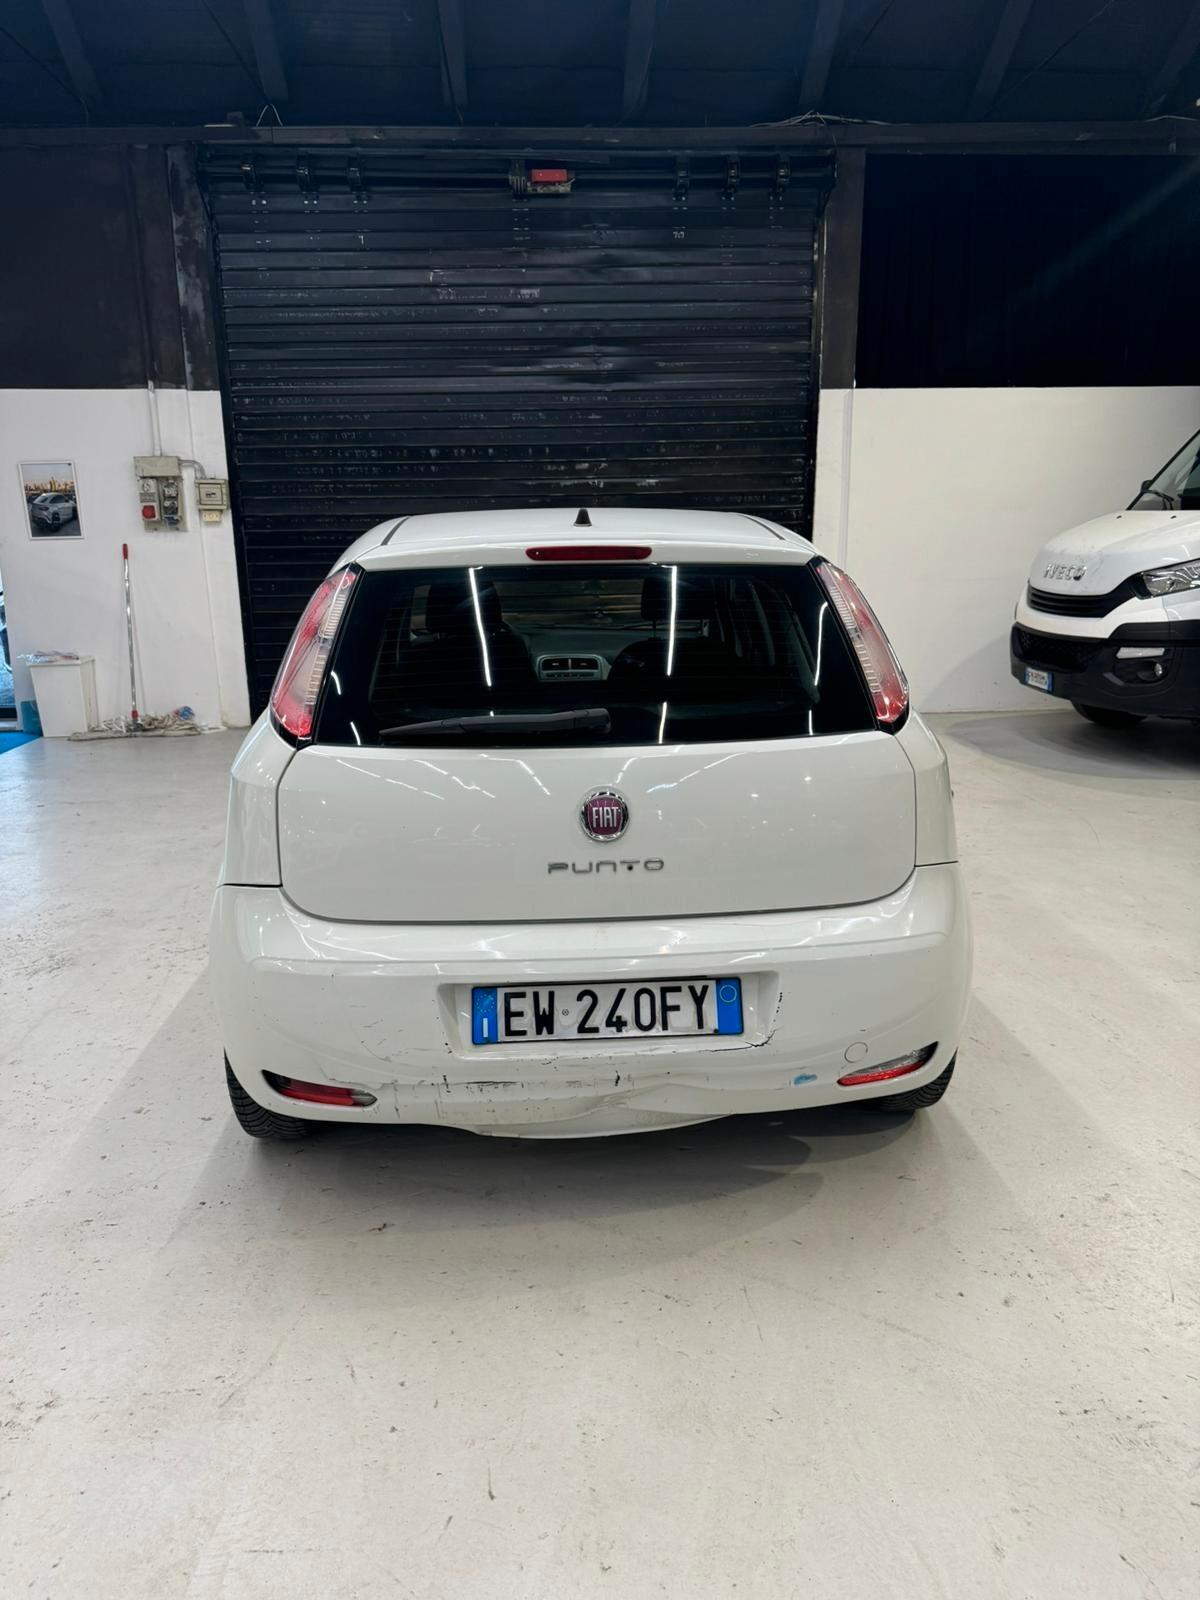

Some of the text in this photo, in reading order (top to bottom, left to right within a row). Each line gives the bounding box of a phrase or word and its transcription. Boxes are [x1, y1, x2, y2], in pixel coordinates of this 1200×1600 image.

[1043, 563, 1087, 581] IVECO
[592, 806, 619, 828] FIAT
[547, 858, 664, 874] PUNTO
[504, 990, 555, 1037] EW
